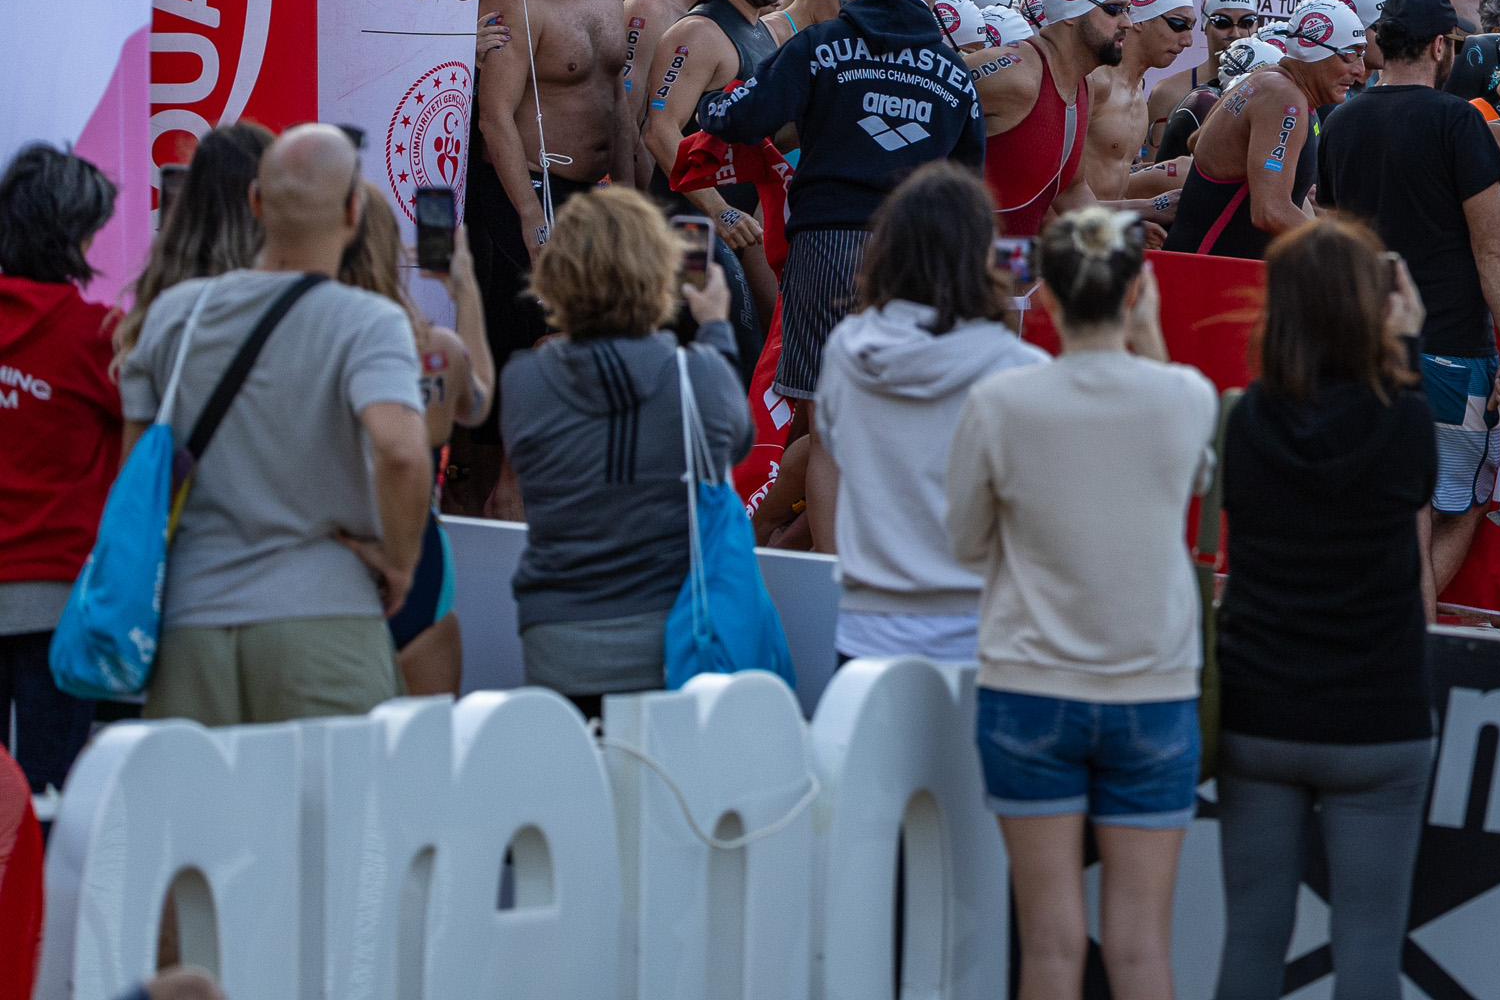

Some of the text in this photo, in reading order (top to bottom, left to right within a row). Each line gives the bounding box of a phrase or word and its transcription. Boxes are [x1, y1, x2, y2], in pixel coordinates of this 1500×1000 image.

[1352, 29, 1365, 38] are
[656, 55, 684, 98] 854
[837, 69, 960, 108] SWIMMING CHAMPIONSHIPS
[863, 92, 932, 123] arena
[1271, 115, 1296, 161] 614
